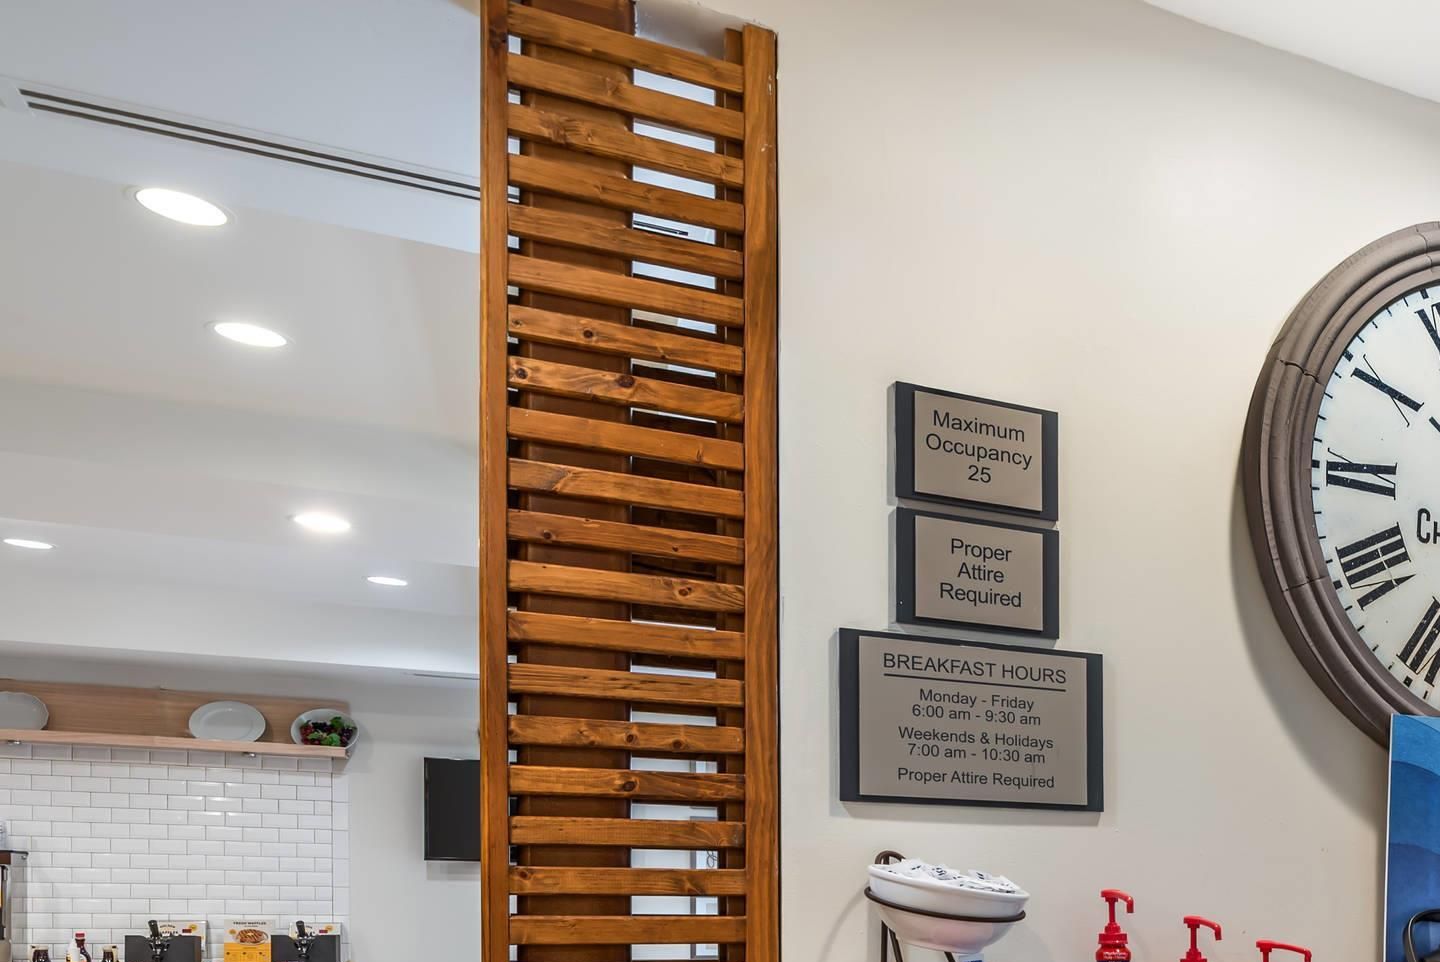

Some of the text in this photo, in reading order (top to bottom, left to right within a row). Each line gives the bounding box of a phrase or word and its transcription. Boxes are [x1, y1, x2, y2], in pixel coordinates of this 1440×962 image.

[1351, 355, 1423, 427] X
[932, 409, 1026, 442] Maximum
[925, 433, 1033, 470] Occupancy
[967, 464, 992, 483] 25
[1325, 448, 1398, 500] IX
[950, 538, 1012, 563] Proper
[957, 562, 1005, 583] Attire
[1334, 522, 1417, 610] VIII
[939, 582, 1022, 608] Required
[883, 652, 1067, 684] BREAKFAST HOURS
[919, 688, 977, 708] Monday
[991, 694, 1034, 712] Friday
[912, 704, 944, 719] 6:00
[948, 709, 971, 721] am
[985, 710, 1016, 724] 9:30
[1019, 714, 1041, 726] am
[897, 726, 1054, 750] Weekends & Holidays
[908, 743, 940, 757] 7:00
[944, 748, 966, 759] am
[982, 748, 1020, 763] 10:30
[1023, 753, 1046, 764] am
[898, 767, 1055, 790] Proper Attire Required
